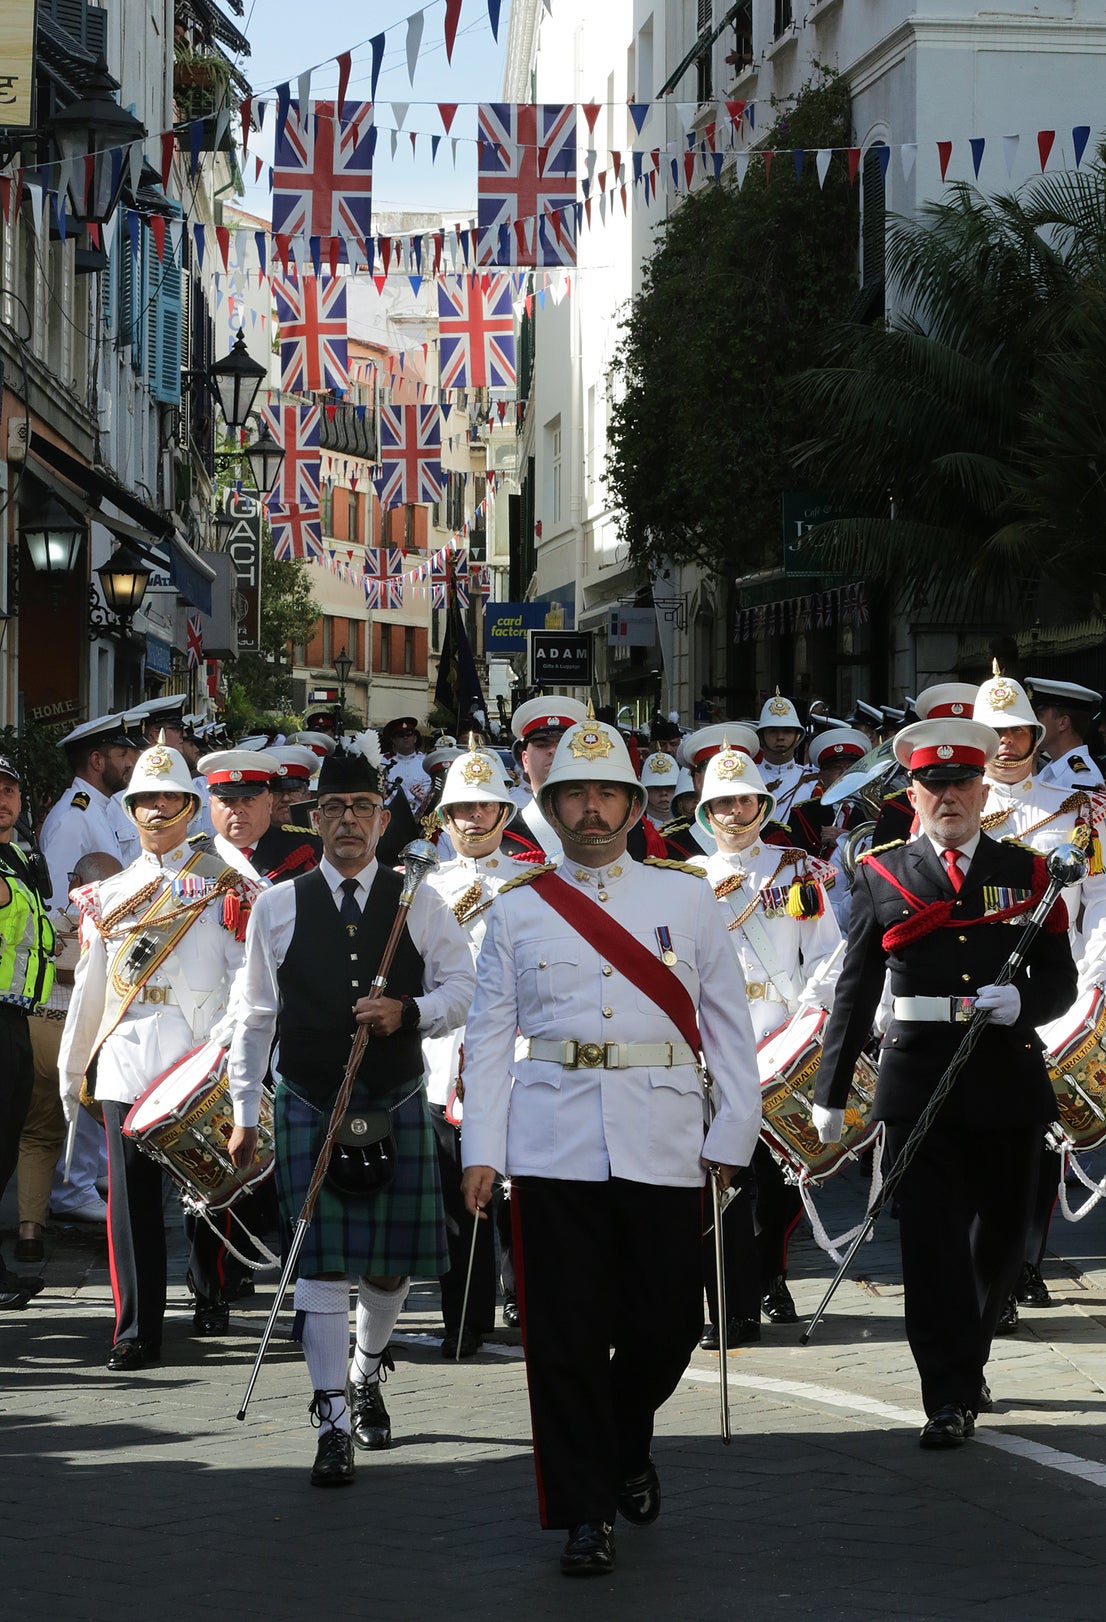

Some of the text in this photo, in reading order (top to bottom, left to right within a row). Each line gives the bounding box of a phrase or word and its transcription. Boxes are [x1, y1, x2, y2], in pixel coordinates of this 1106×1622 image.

[497, 615, 522, 626] card
[491, 625, 528, 640] factory
[536, 648, 588, 659] ADAM
[32, 700, 74, 719] HOME
[763, 1094, 786, 1111] ROYAL
